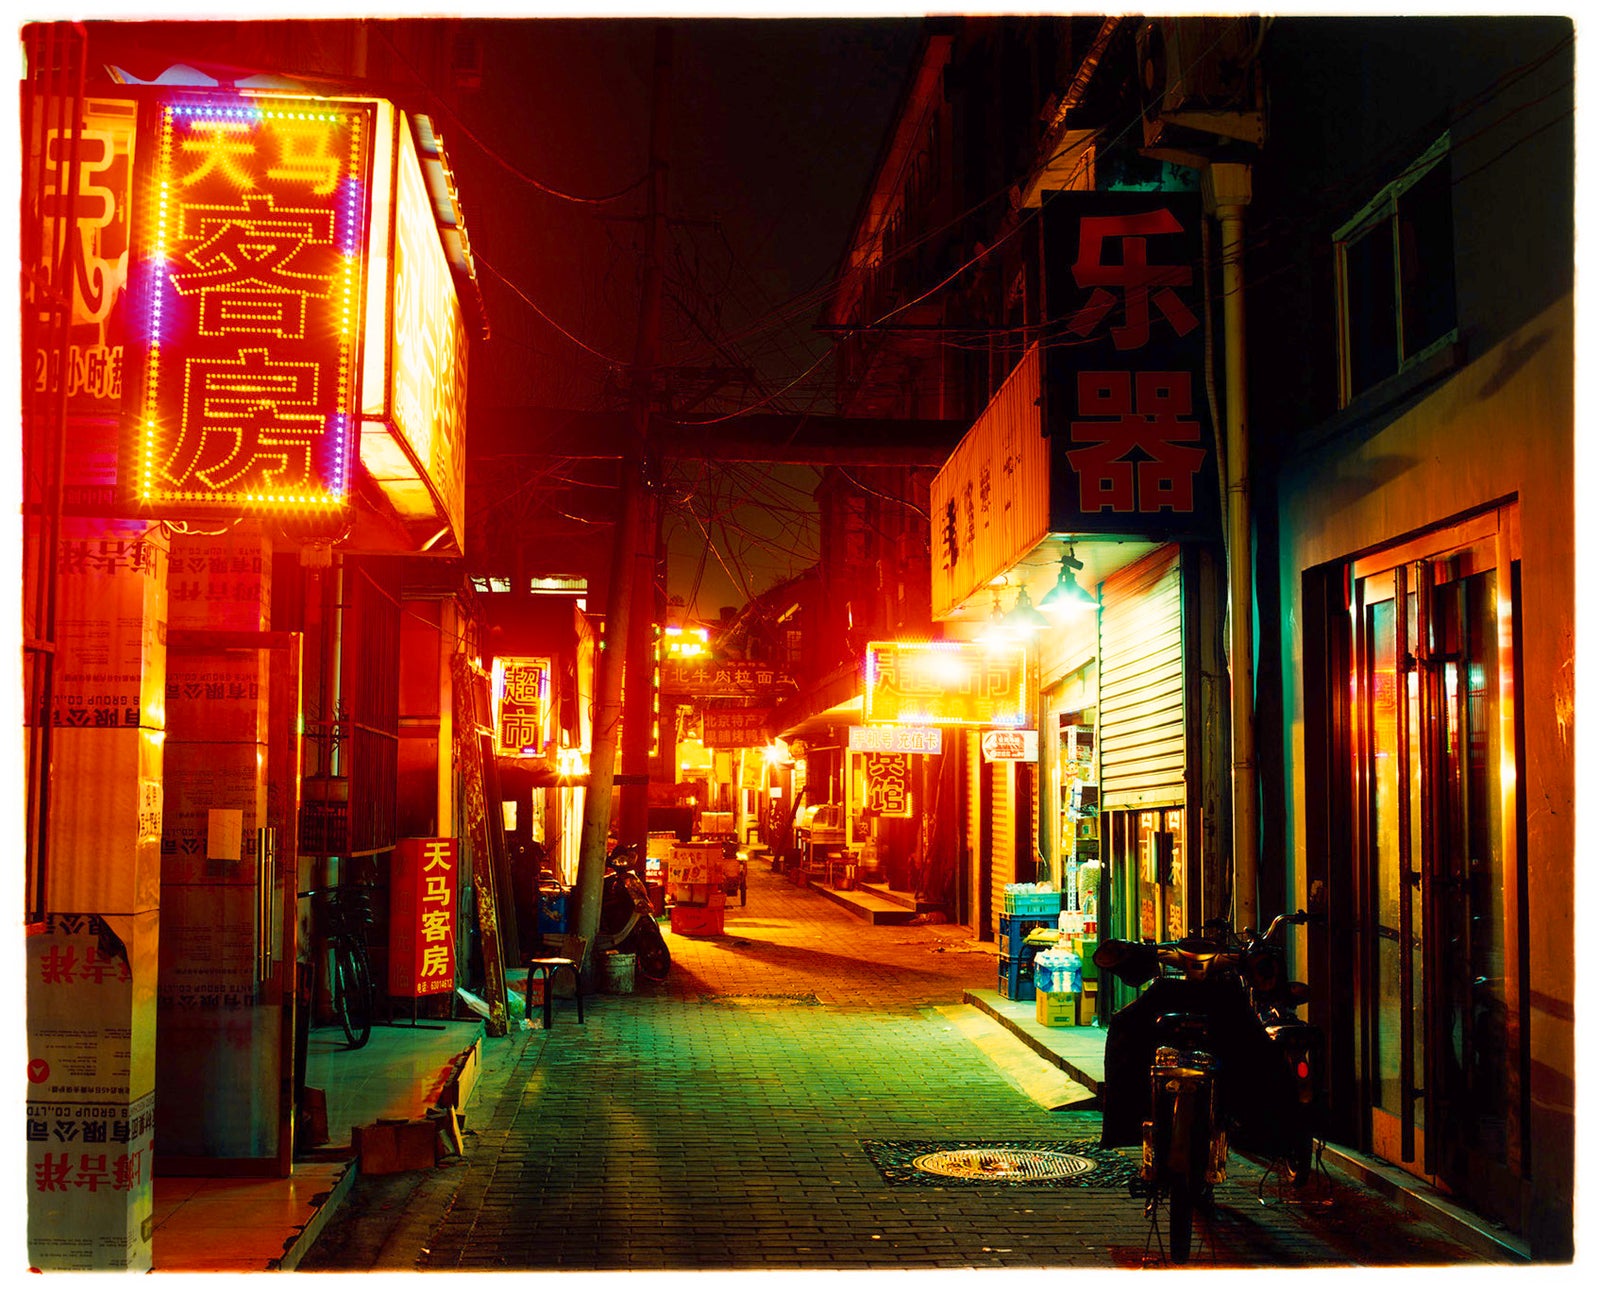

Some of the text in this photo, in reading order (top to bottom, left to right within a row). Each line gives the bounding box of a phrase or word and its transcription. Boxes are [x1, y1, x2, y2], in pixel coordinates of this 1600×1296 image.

[182, 119, 343, 195] 天马
[161, 194, 337, 491] 客房
[1067, 207, 1207, 512] 乐器
[87, 695, 128, 705] GROUP
[503, 666, 540, 749] 超市
[853, 731, 939, 750] 手机号 充值卡
[420, 842, 452, 978] 天马客房
[27, 1106, 71, 1117] CO.,LTD
[75, 1107, 116, 1117] GROUP
